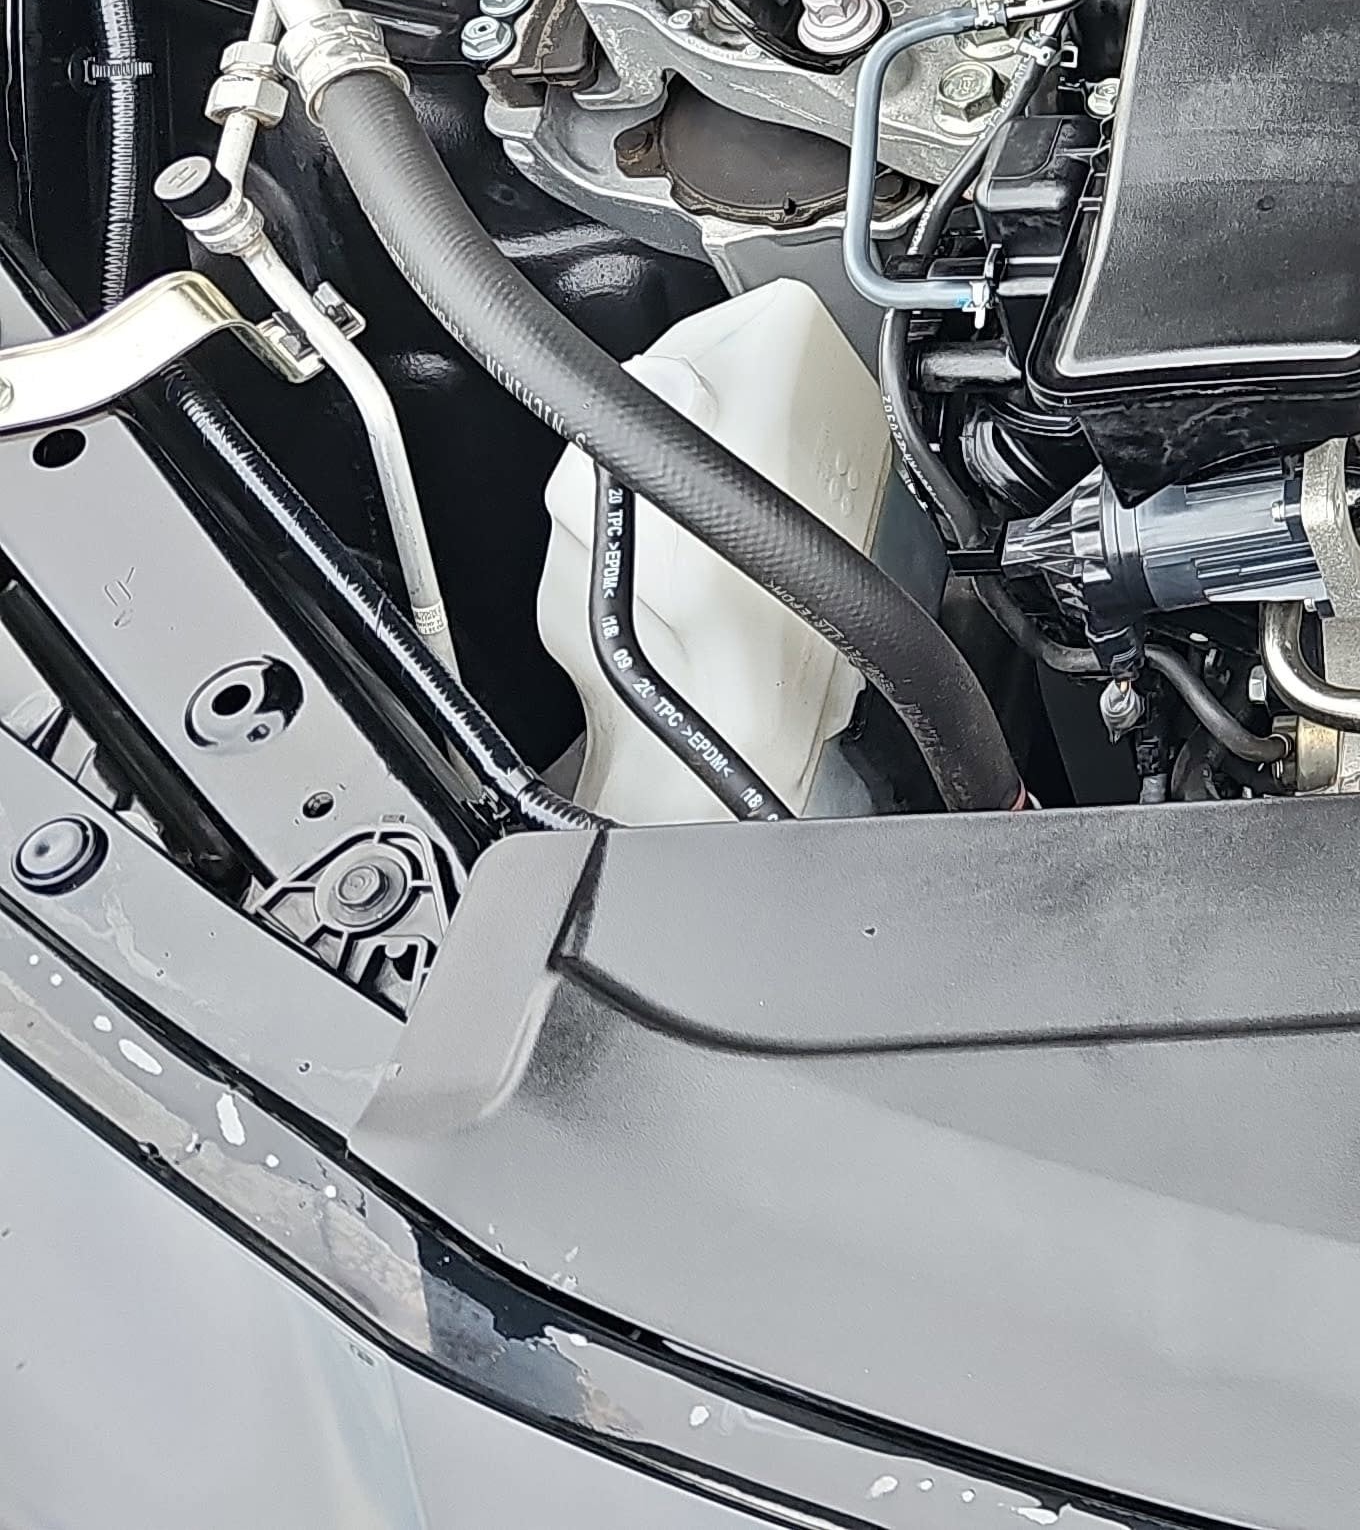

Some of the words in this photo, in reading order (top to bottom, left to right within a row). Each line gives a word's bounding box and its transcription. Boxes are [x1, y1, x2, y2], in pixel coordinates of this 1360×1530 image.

[606, 508, 624, 537] TPC
[650, 696, 686, 730] TPC
[679, 723, 735, 780] >EPDM<
